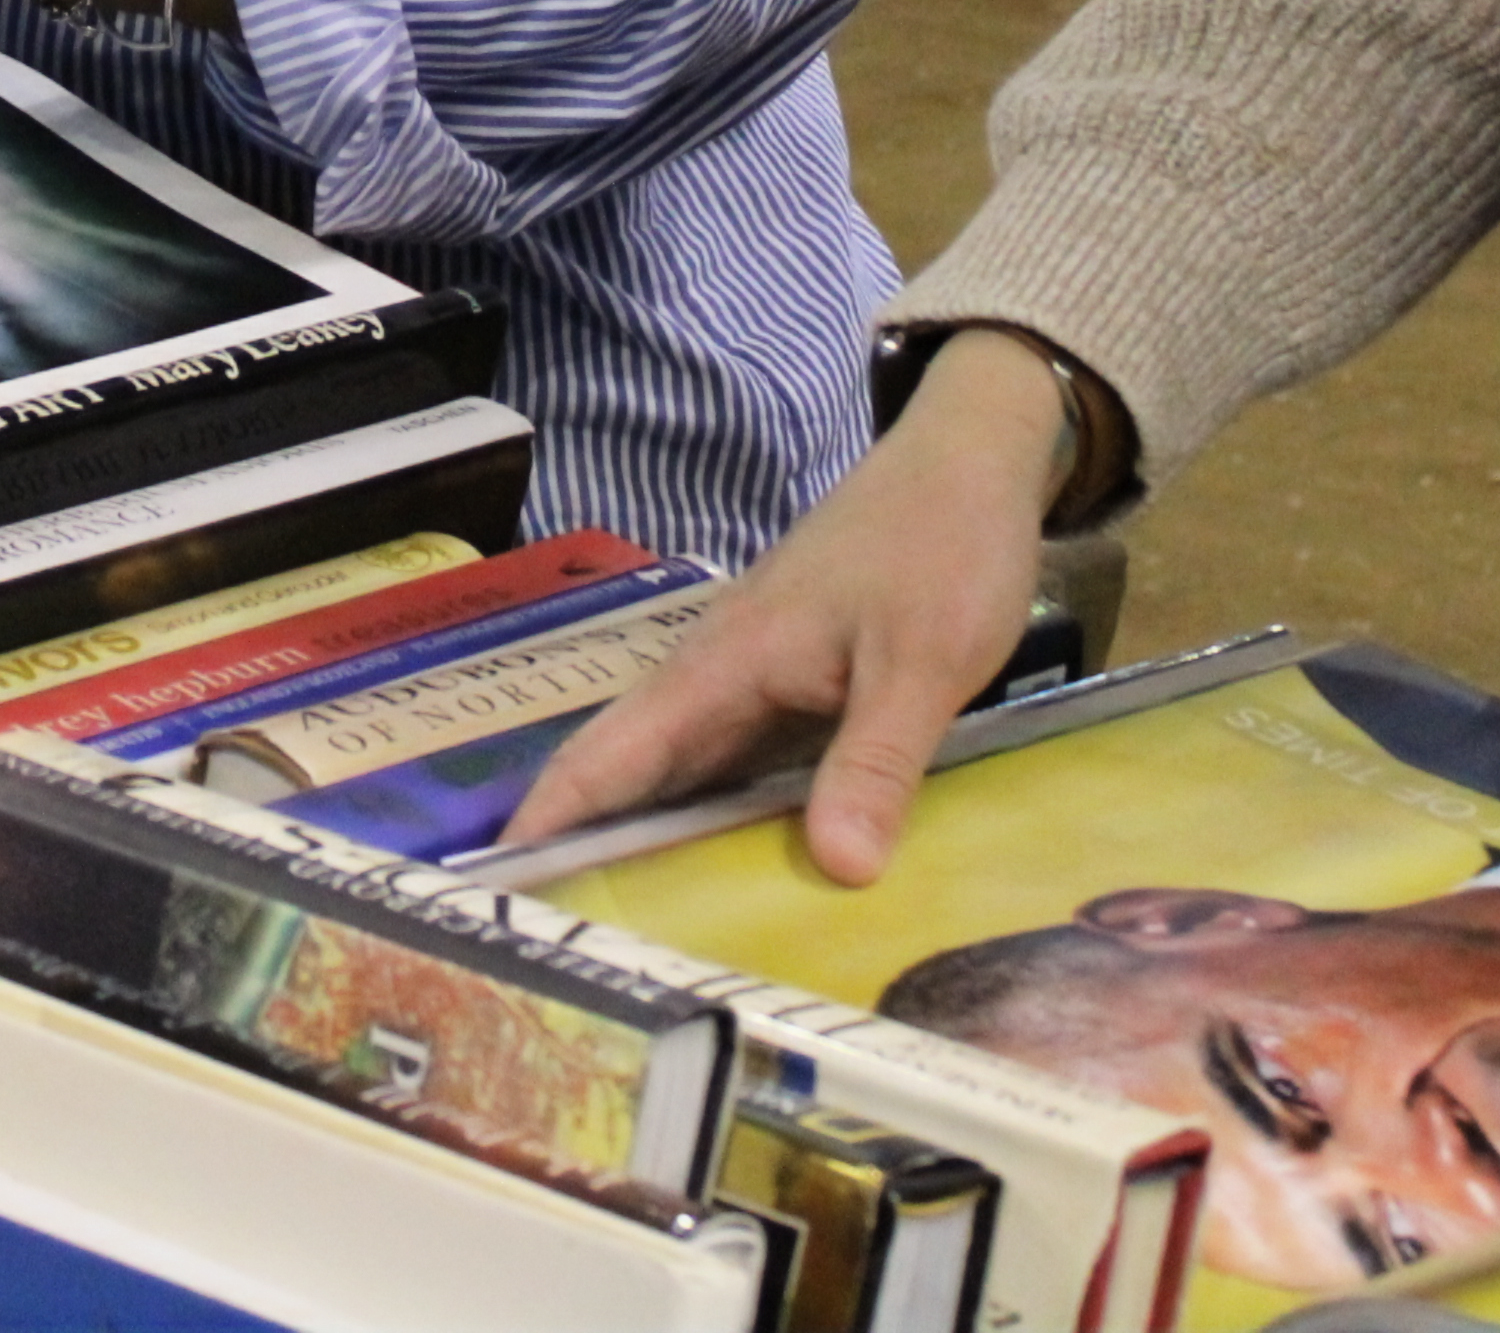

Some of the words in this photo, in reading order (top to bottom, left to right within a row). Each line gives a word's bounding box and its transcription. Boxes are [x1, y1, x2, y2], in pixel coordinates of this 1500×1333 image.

[126, 347, 239, 392] Mary
[243, 308, 387, 361] Leakey
[384, 403, 480, 437] TASCHEN
[111, 644, 312, 716] hepburn
[299, 615, 630, 733] AUDUBON'S
[325, 714, 400, 757] OF
[412, 649, 619, 732] NORTH
[1224, 704, 1381, 785] TIMES
[1385, 786, 1479, 825] OF
